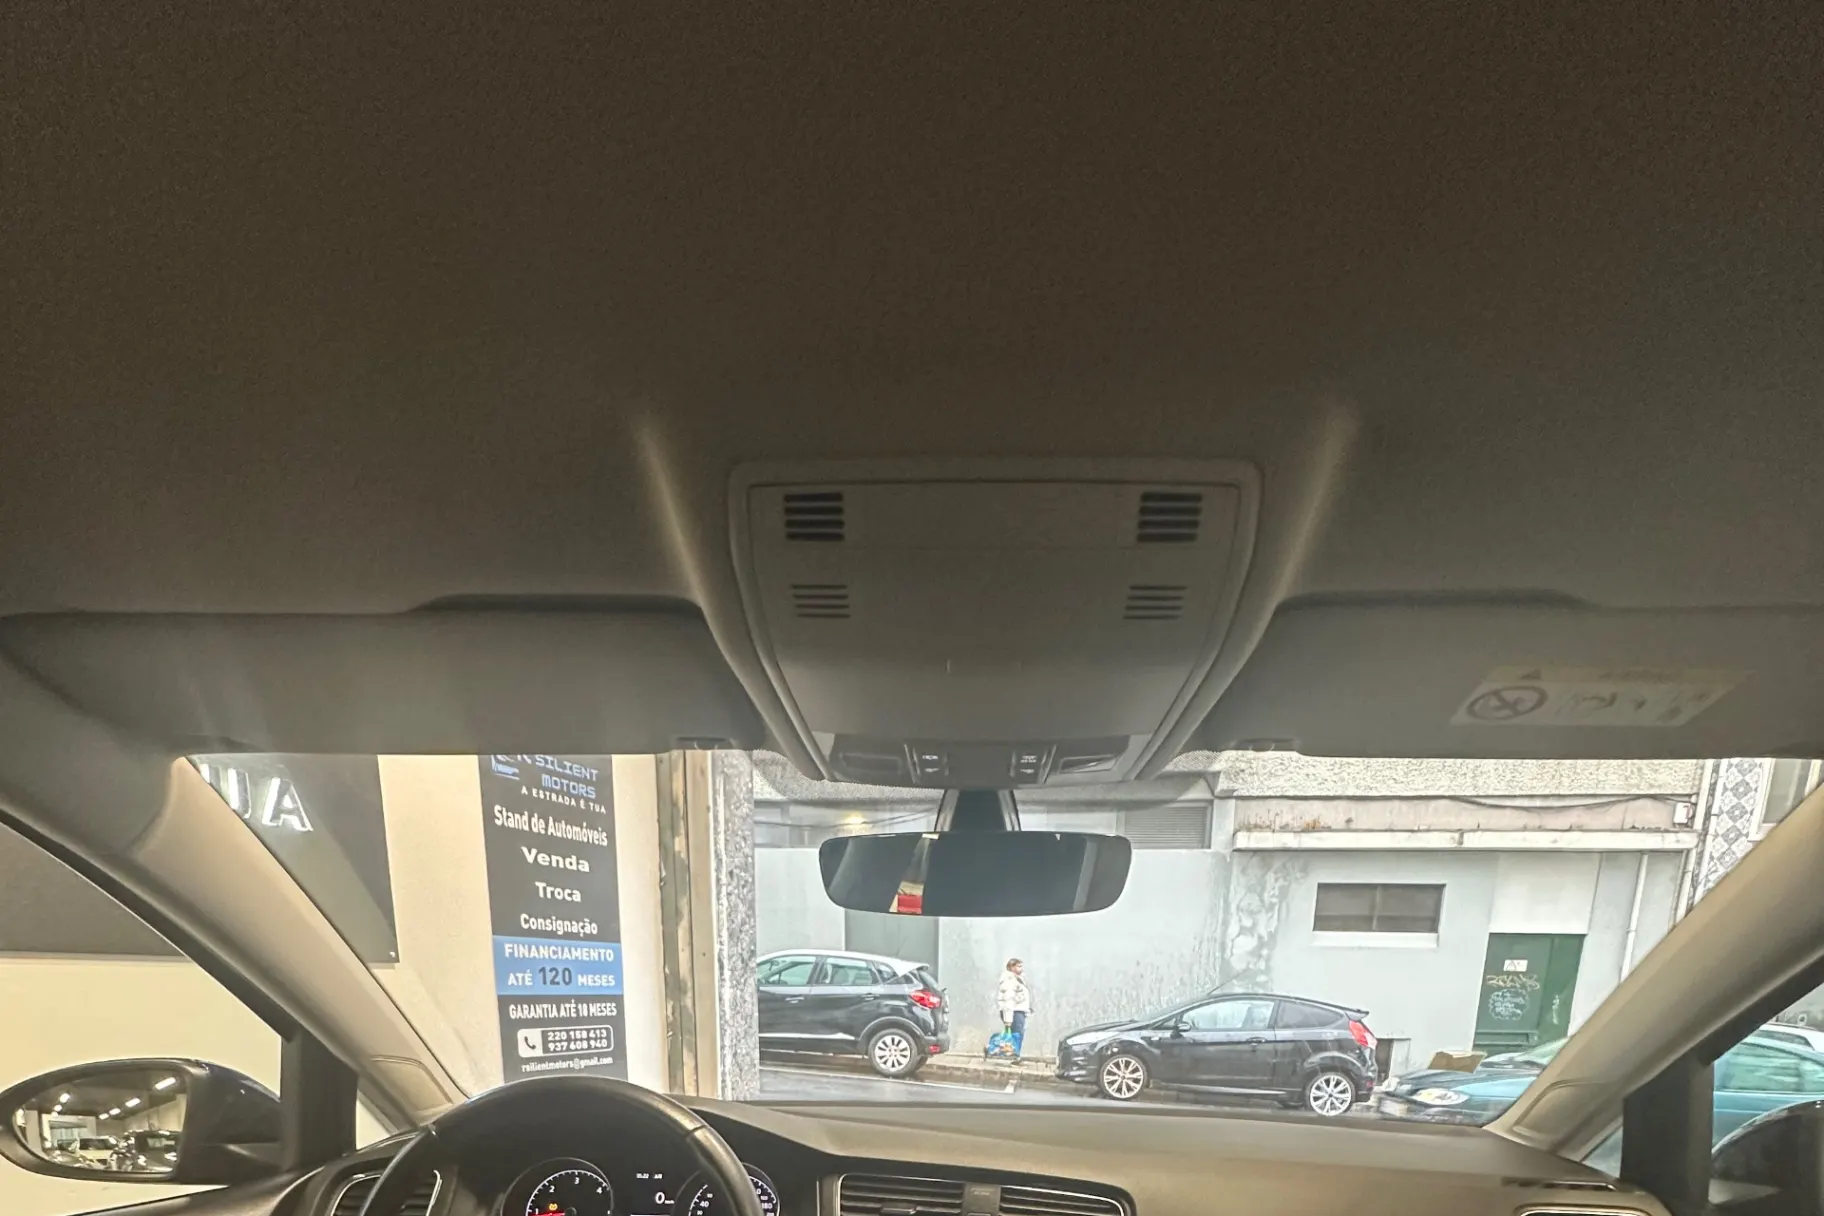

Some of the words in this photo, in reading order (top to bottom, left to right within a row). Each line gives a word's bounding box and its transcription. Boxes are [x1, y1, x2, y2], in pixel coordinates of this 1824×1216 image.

[541, 774, 596, 799] MOTORS
[521, 785, 528, 796] A
[532, 788, 576, 807] ESTRADA
[589, 802, 606, 815] TUA
[494, 804, 529, 832] Stand
[531, 813, 546, 835] de
[547, 816, 608, 847] Automóveis
[521, 846, 590, 873] Venda
[535, 881, 582, 902] Troca
[520, 913, 598, 937] Consignação
[504, 943, 614, 962] FINANCIAMENTO
[507, 969, 533, 986] ATÉ
[538, 966, 573, 986] 120
[577, 974, 616, 986] MESES
[509, 1003, 559, 1019] GARANTIA
[559, 998, 577, 1018] ATÉ
[577, 1003, 588, 1017] 18
[589, 1002, 617, 1017] MESES
[547, 1031, 568, 1041] 220
[589, 1029, 607, 1038] 413
[548, 1041, 568, 1052] 937
[589, 1039, 608, 1049] 940
[549, 1185, 555, 1193] 2
[574, 1177, 580, 1185] 3
[655, 1191, 665, 1204] 0
